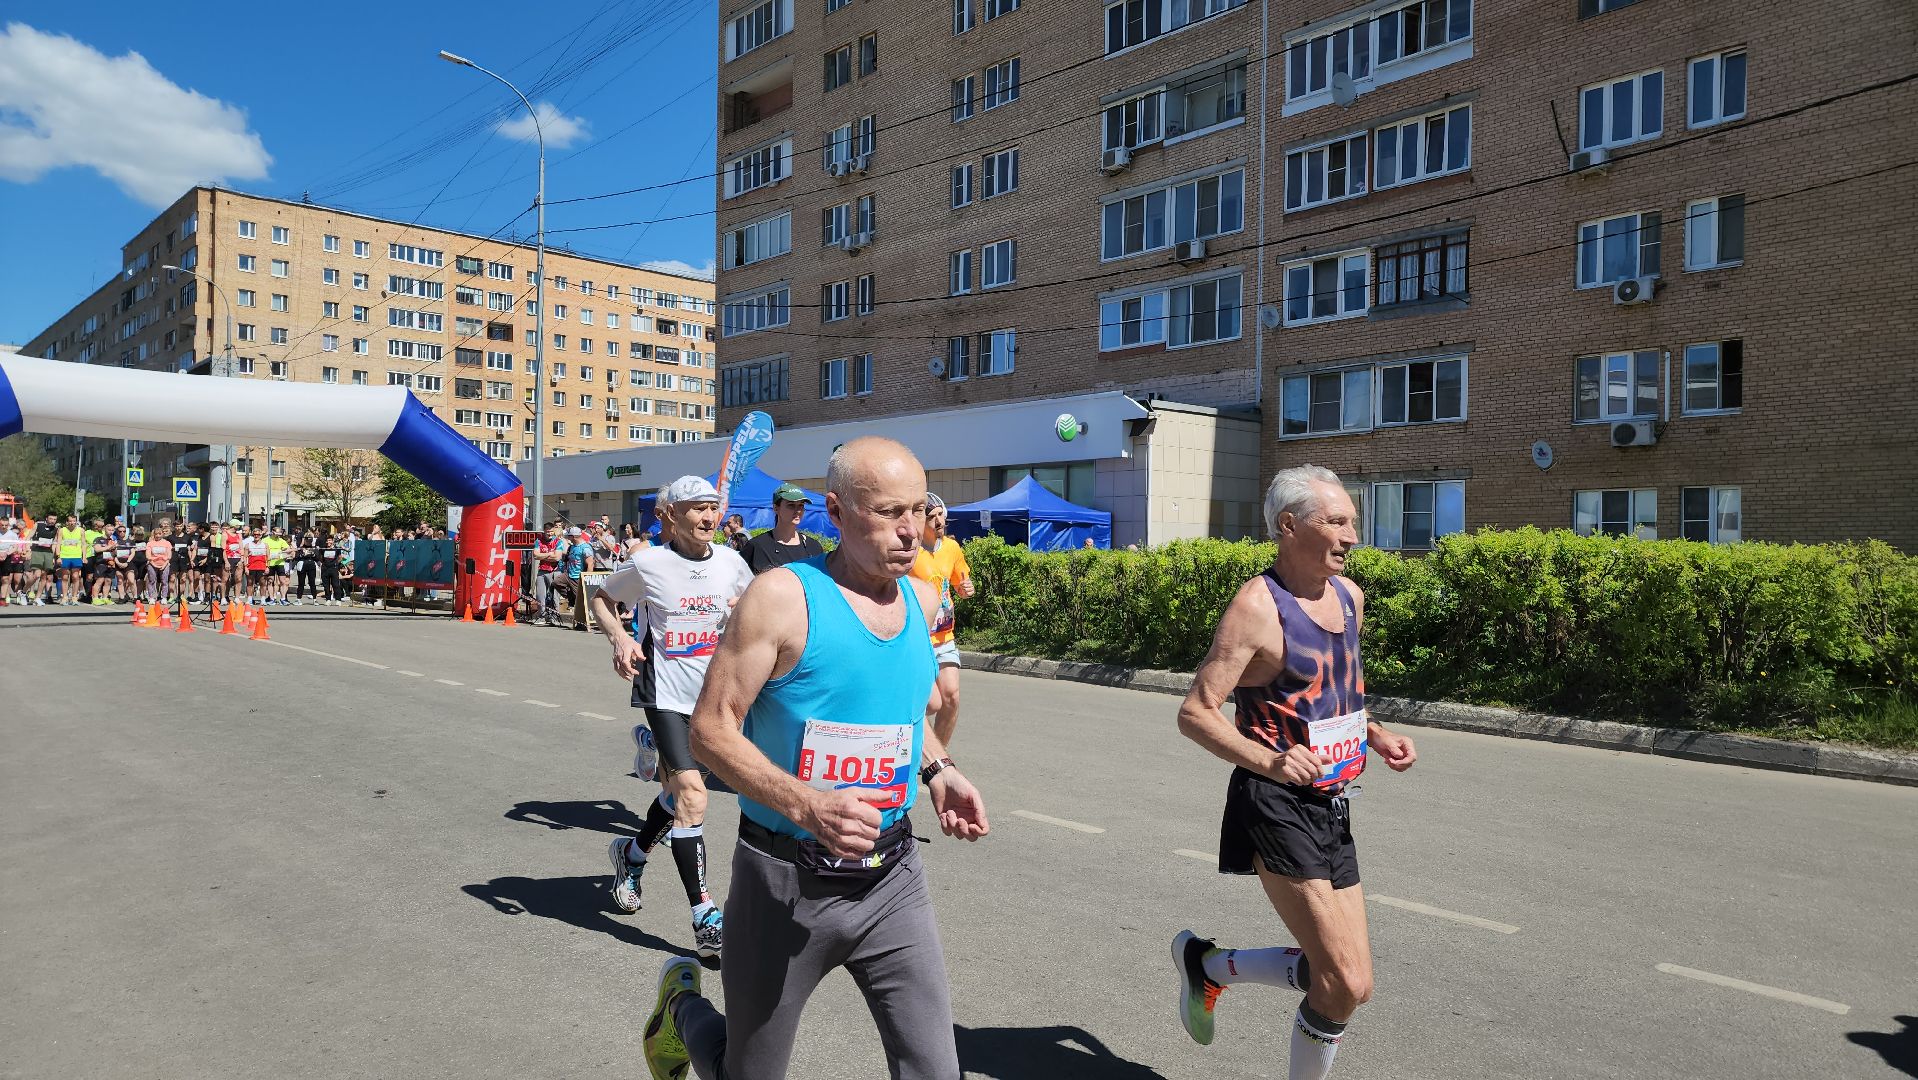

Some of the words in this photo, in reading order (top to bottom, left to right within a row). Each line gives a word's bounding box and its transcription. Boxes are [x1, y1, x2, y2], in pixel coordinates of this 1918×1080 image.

[724, 412, 757, 481] ZEPPELIN
[478, 502, 517, 610] ФИНИШ
[677, 631, 718, 646] 1046
[822, 754, 896, 784] 1015
